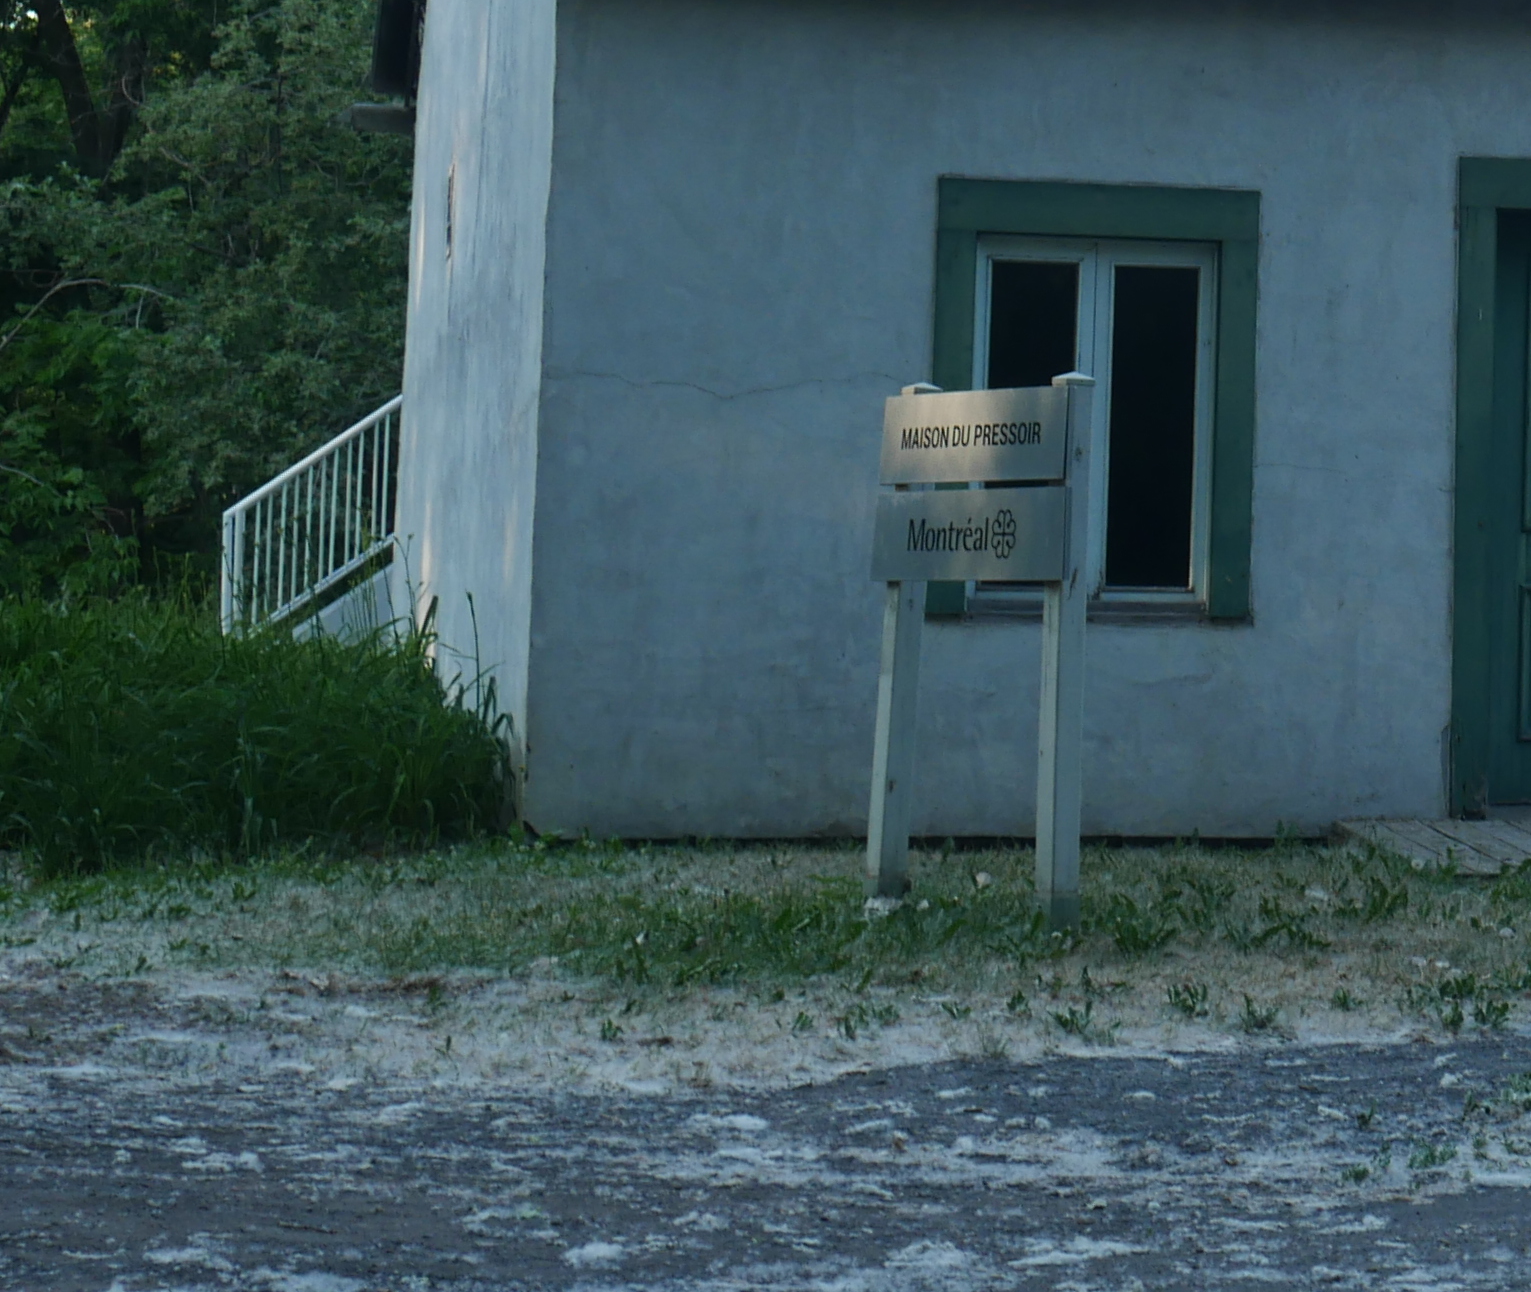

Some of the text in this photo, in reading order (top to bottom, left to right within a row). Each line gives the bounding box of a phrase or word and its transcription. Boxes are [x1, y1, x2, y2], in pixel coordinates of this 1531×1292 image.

[901, 422, 1041, 450] MAISON DU PRESSOIR
[906, 516, 989, 552] Montréal
